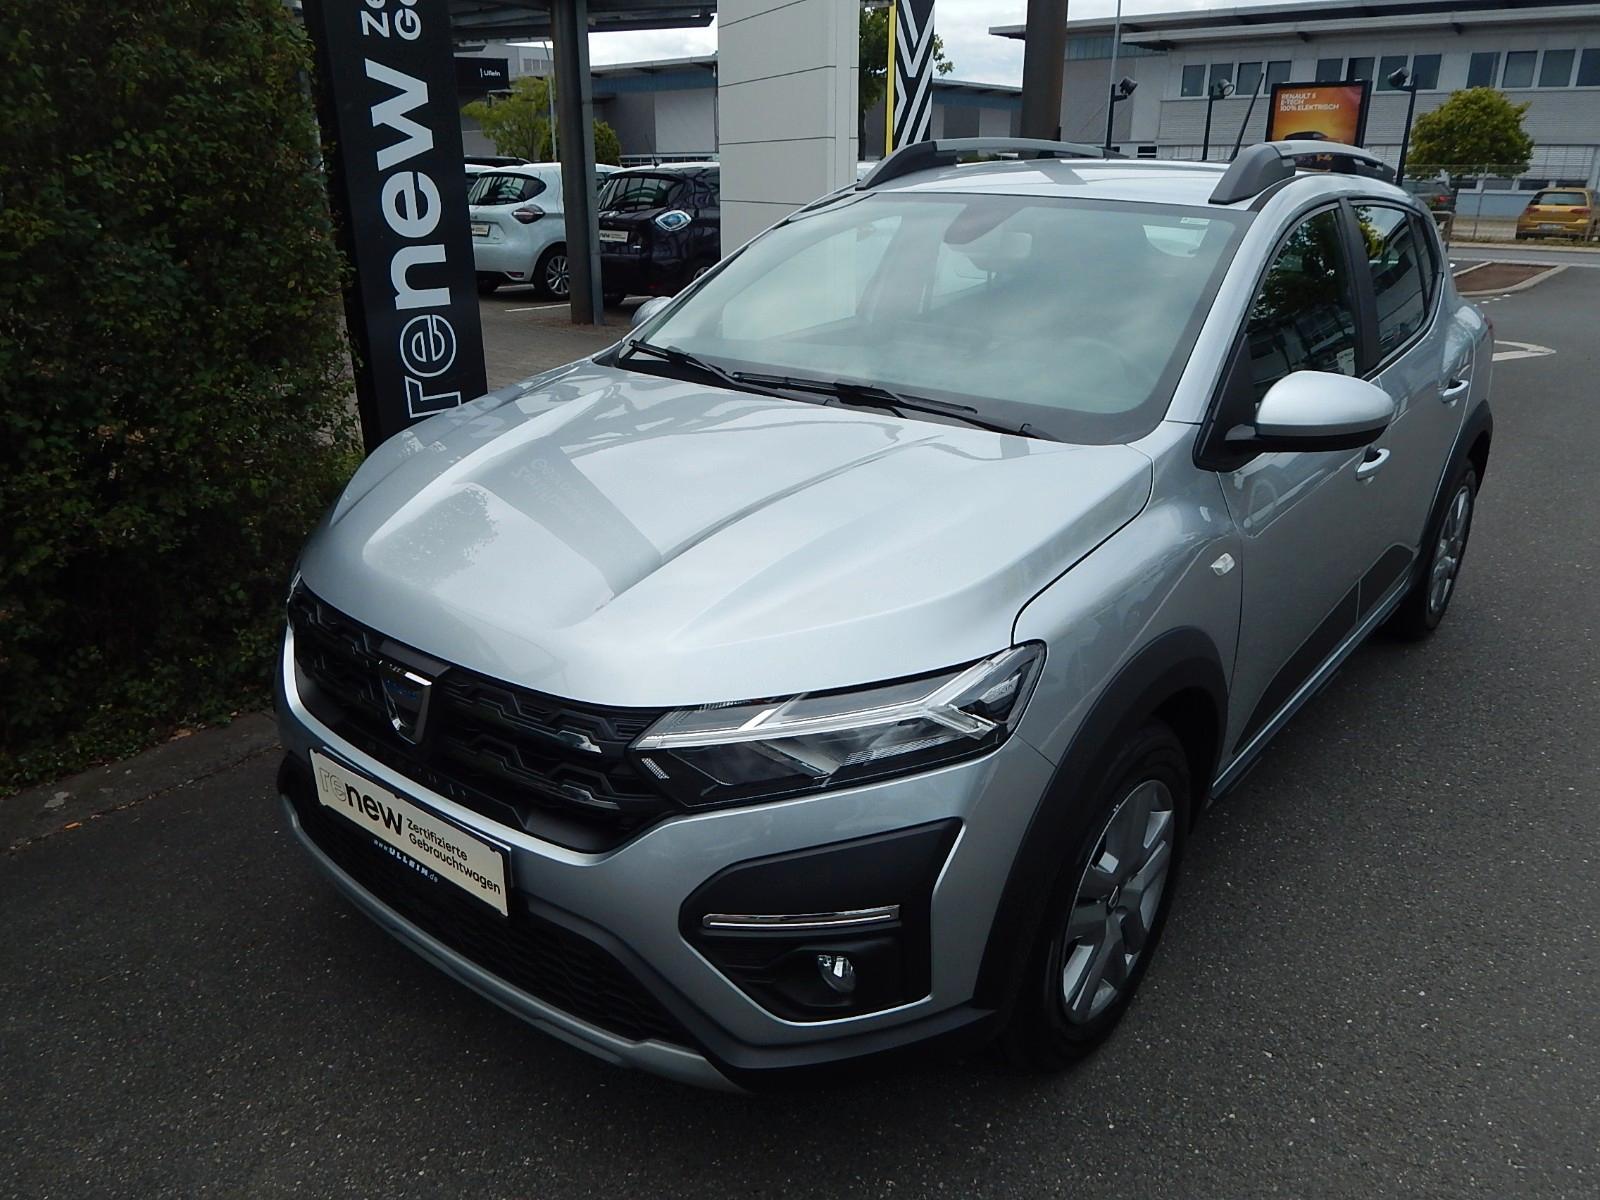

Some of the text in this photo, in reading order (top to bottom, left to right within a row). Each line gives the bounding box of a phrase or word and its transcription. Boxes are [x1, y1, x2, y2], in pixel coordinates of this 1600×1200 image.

[394, 0, 422, 40] G
[1280, 103, 1340, 112] 100% ELEKTRISCH
[1281, 92, 1311, 100] RENAULT
[364, 57, 462, 420] renew
[319, 767, 403, 836] renew
[406, 818, 468, 861] Zertifizierte
[408, 832, 501, 895] Gebrauchtwagen
